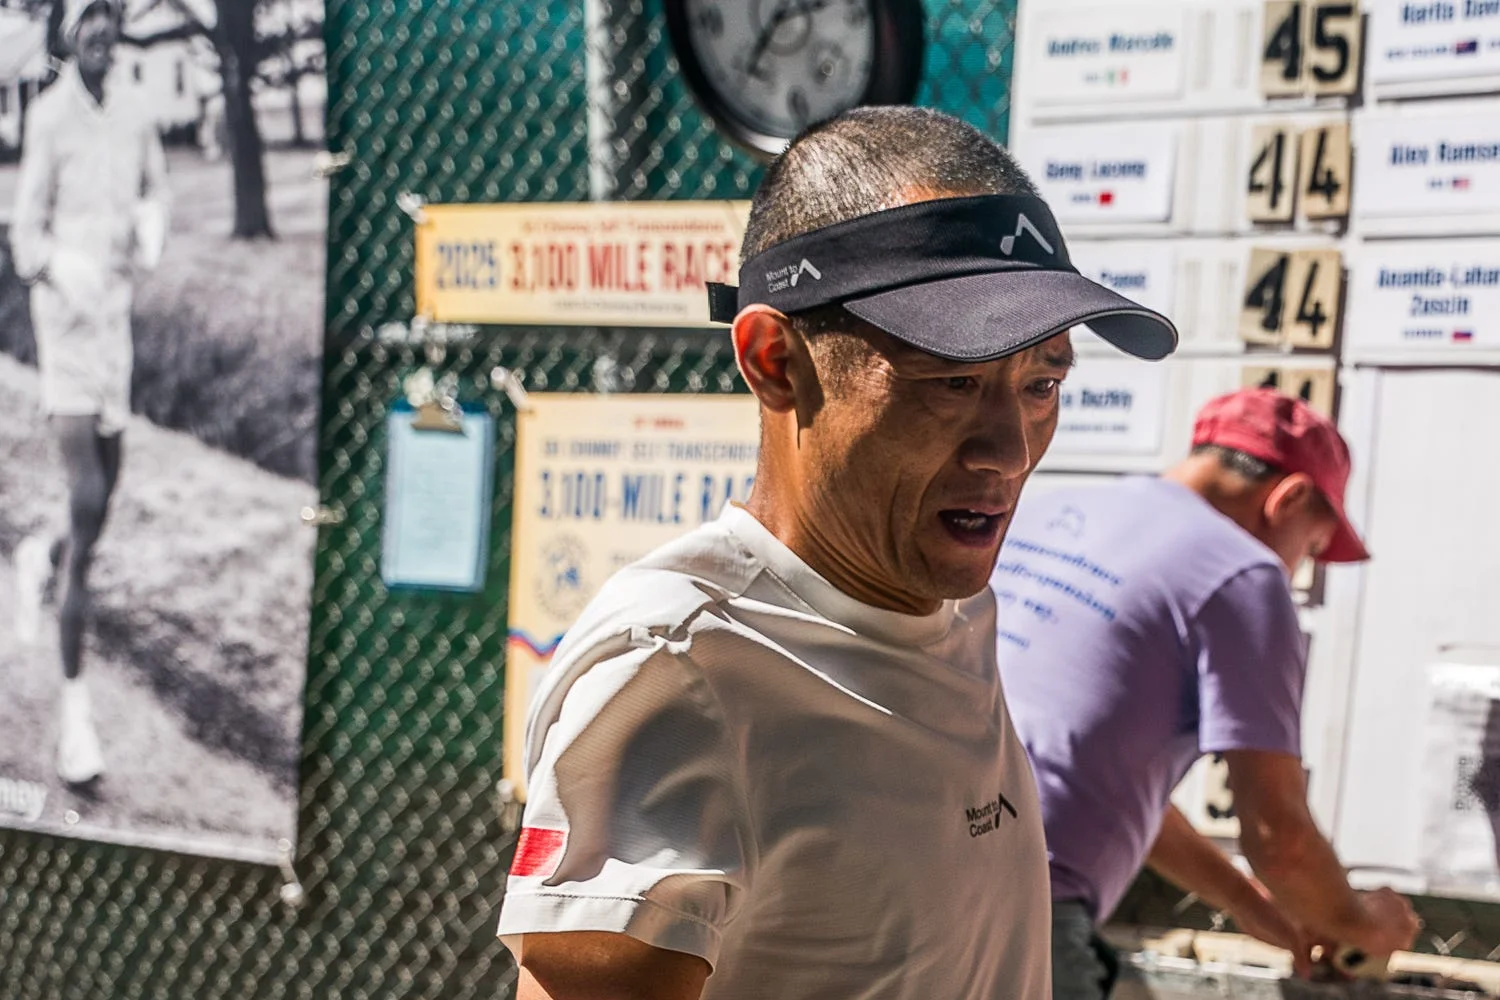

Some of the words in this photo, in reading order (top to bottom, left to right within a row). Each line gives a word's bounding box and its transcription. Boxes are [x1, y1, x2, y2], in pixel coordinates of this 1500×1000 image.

[1263, 2, 1352, 83] 45
[1248, 129, 1341, 210] 44
[436, 241, 497, 289] 2025
[510, 241, 578, 291] 3,100
[588, 241, 648, 291] MILE
[663, 241, 736, 291] RACE
[765, 266, 788, 281] Mount
[789, 264, 798, 274] to
[768, 278, 789, 293] Coast
[1245, 254, 1327, 338] 44
[966, 803, 992, 821] Mount
[970, 819, 993, 838] Coast
